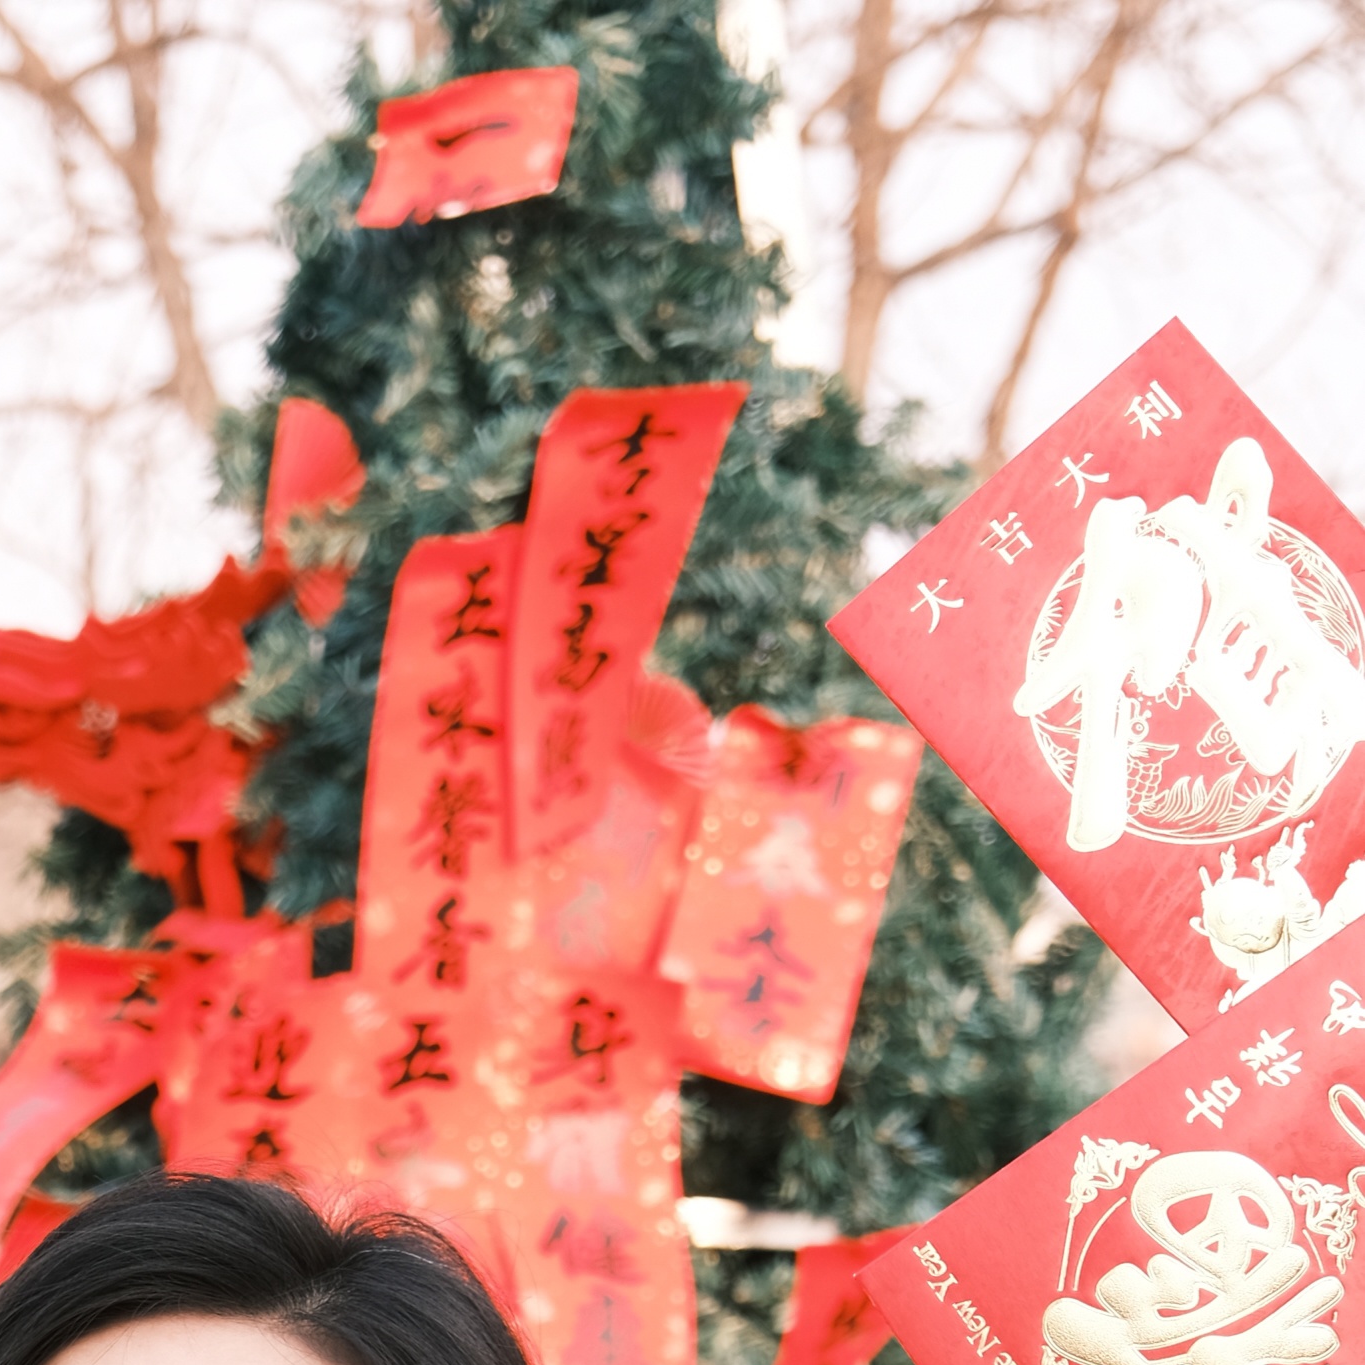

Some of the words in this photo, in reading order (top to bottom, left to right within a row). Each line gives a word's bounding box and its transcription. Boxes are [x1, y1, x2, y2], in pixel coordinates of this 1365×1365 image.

[911, 381, 1181, 632] 大吉大利
[912, 1240, 959, 1303] Year
[952, 1299, 1002, 1358] New
